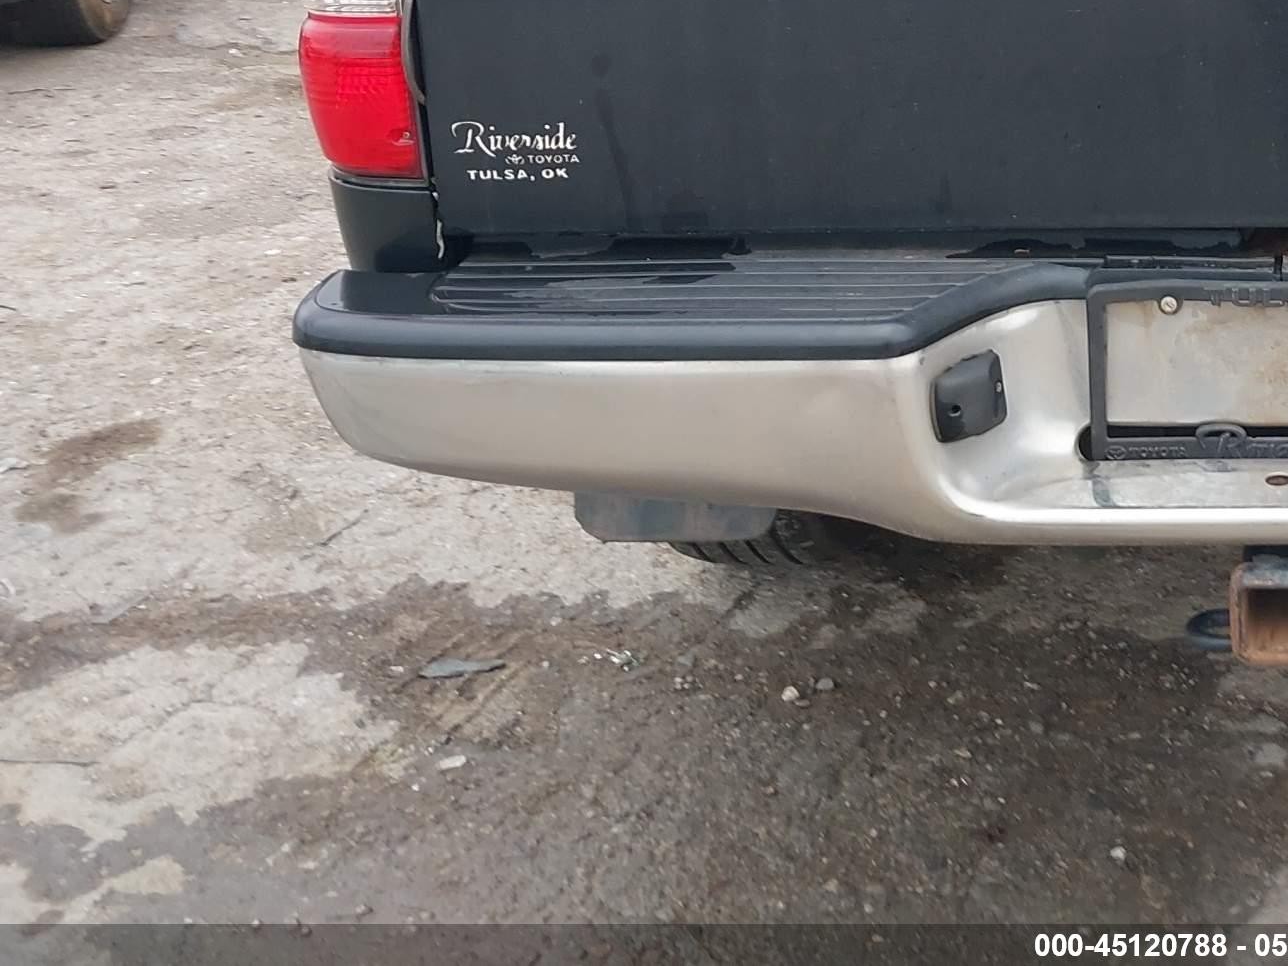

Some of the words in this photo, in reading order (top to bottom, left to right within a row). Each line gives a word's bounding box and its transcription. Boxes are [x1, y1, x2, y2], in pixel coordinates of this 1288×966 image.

[451, 121, 577, 158] Riverside
[527, 154, 580, 164] TOYOTA
[466, 169, 536, 181] TULSA,
[541, 167, 569, 179] OK
[1128, 446, 1188, 459] TOYOTA
